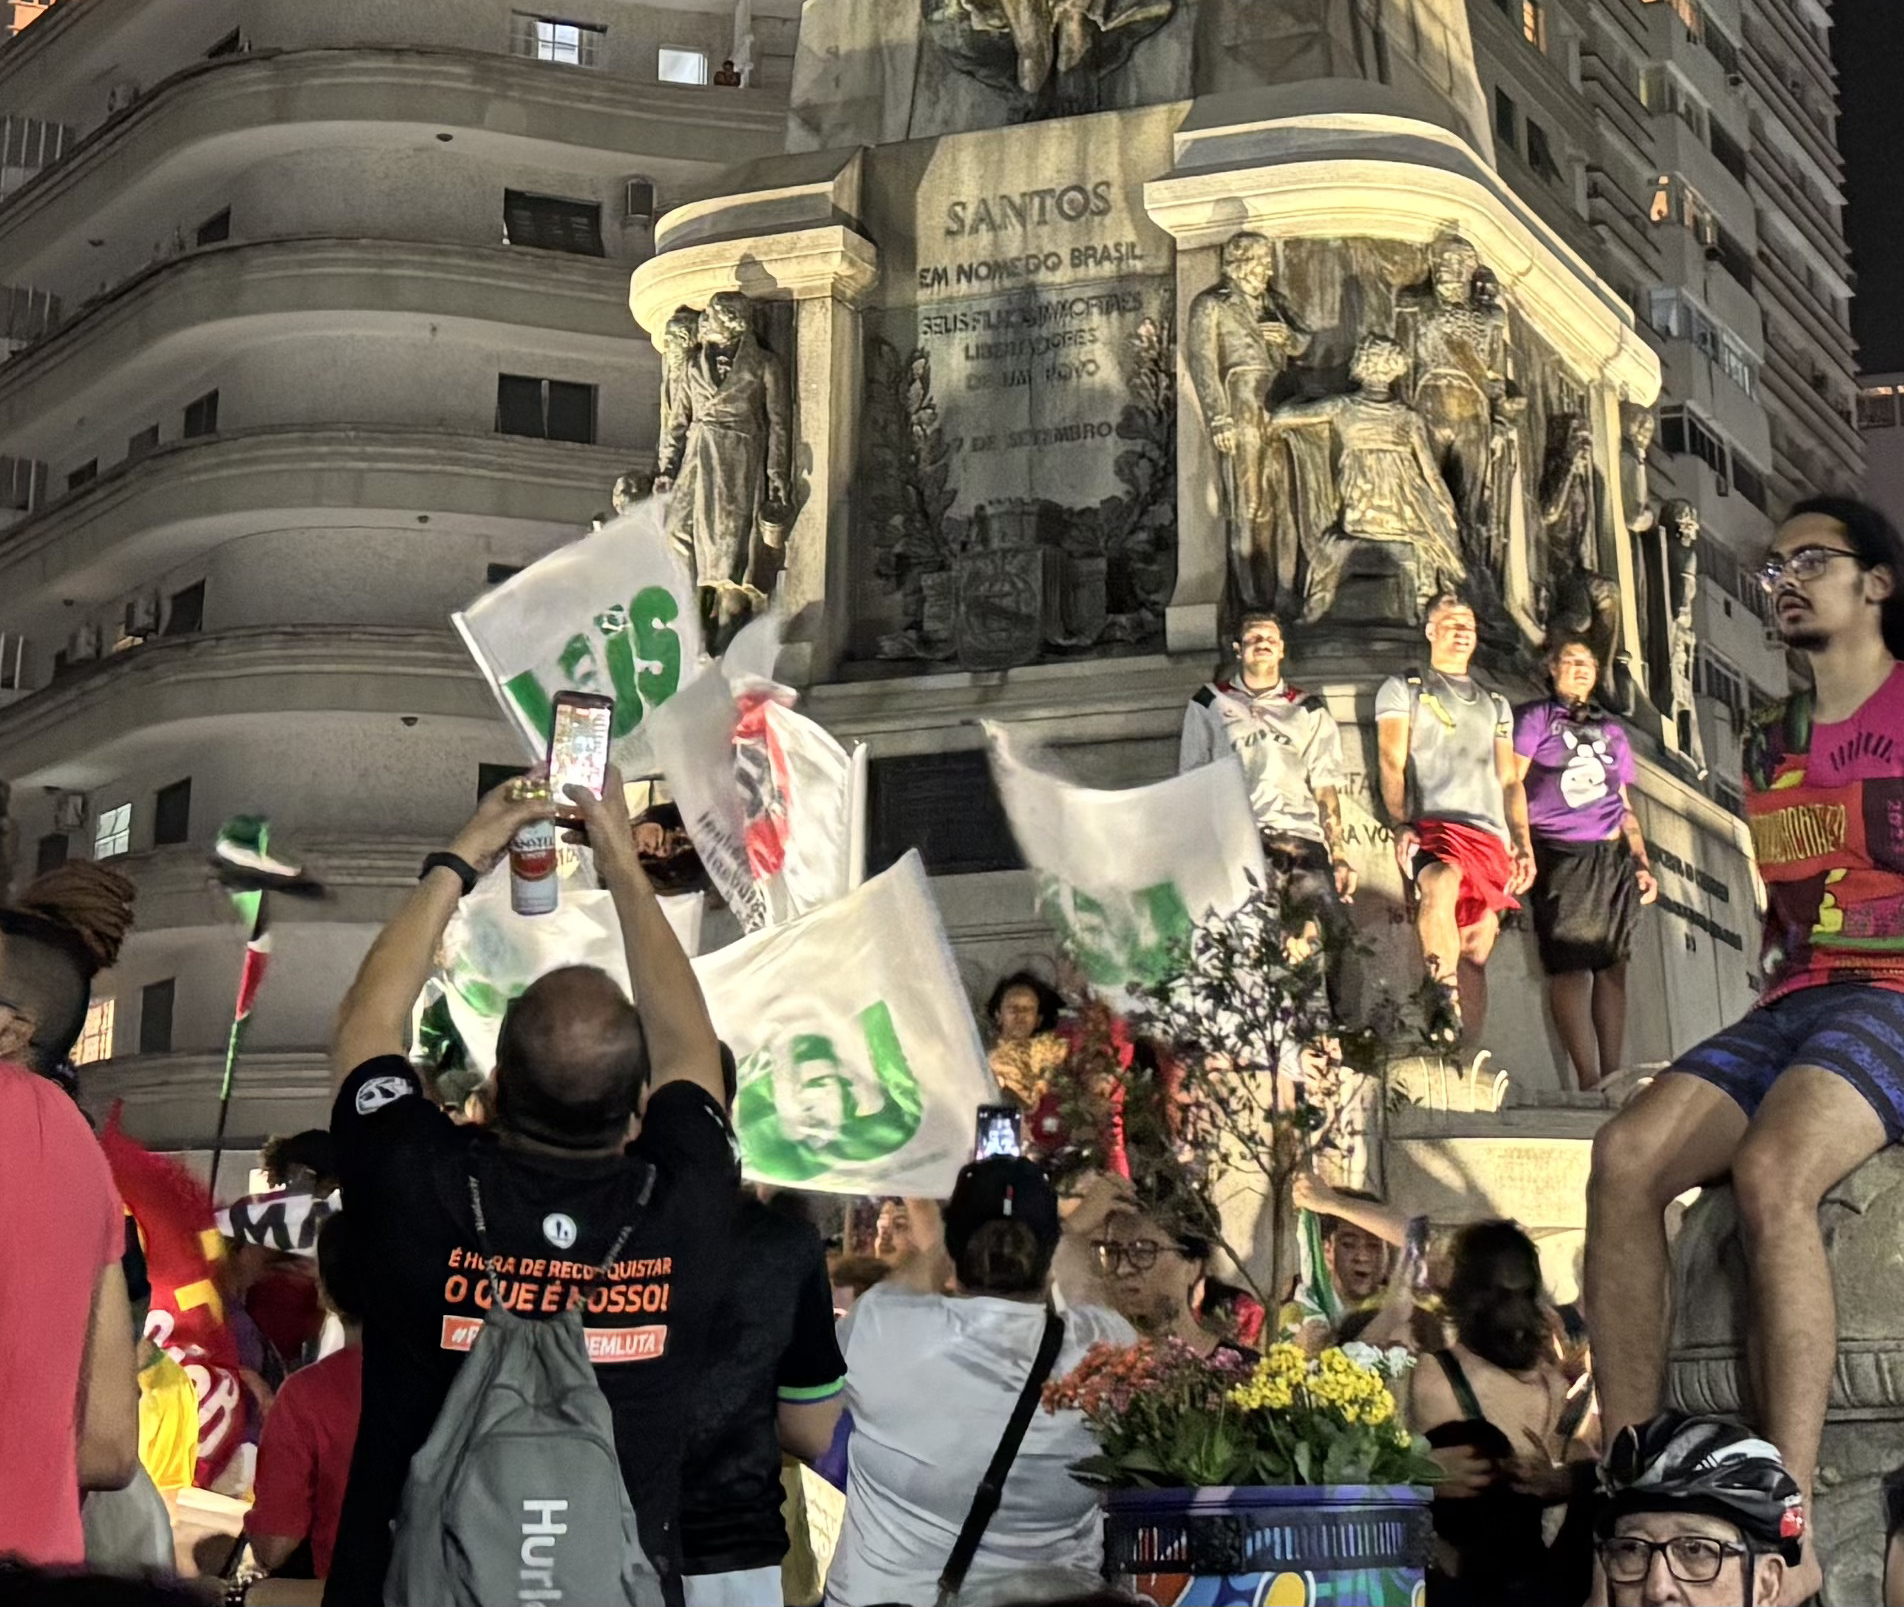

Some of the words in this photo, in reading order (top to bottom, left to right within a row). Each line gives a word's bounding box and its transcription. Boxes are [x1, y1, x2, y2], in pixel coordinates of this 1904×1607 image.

[944, 181, 1112, 237] SANTOS
[919, 266, 949, 289] EM
[956, 257, 1024, 284] NOME
[1025, 252, 1063, 274] DO
[1070, 242, 1144, 269] BRASIL
[448, 1247, 464, 1269] É
[519, 1257, 546, 1277] DE
[548, 1256, 673, 1281] RECOQUISTAR
[444, 1274, 468, 1304] O
[541, 1279, 564, 1313] É
